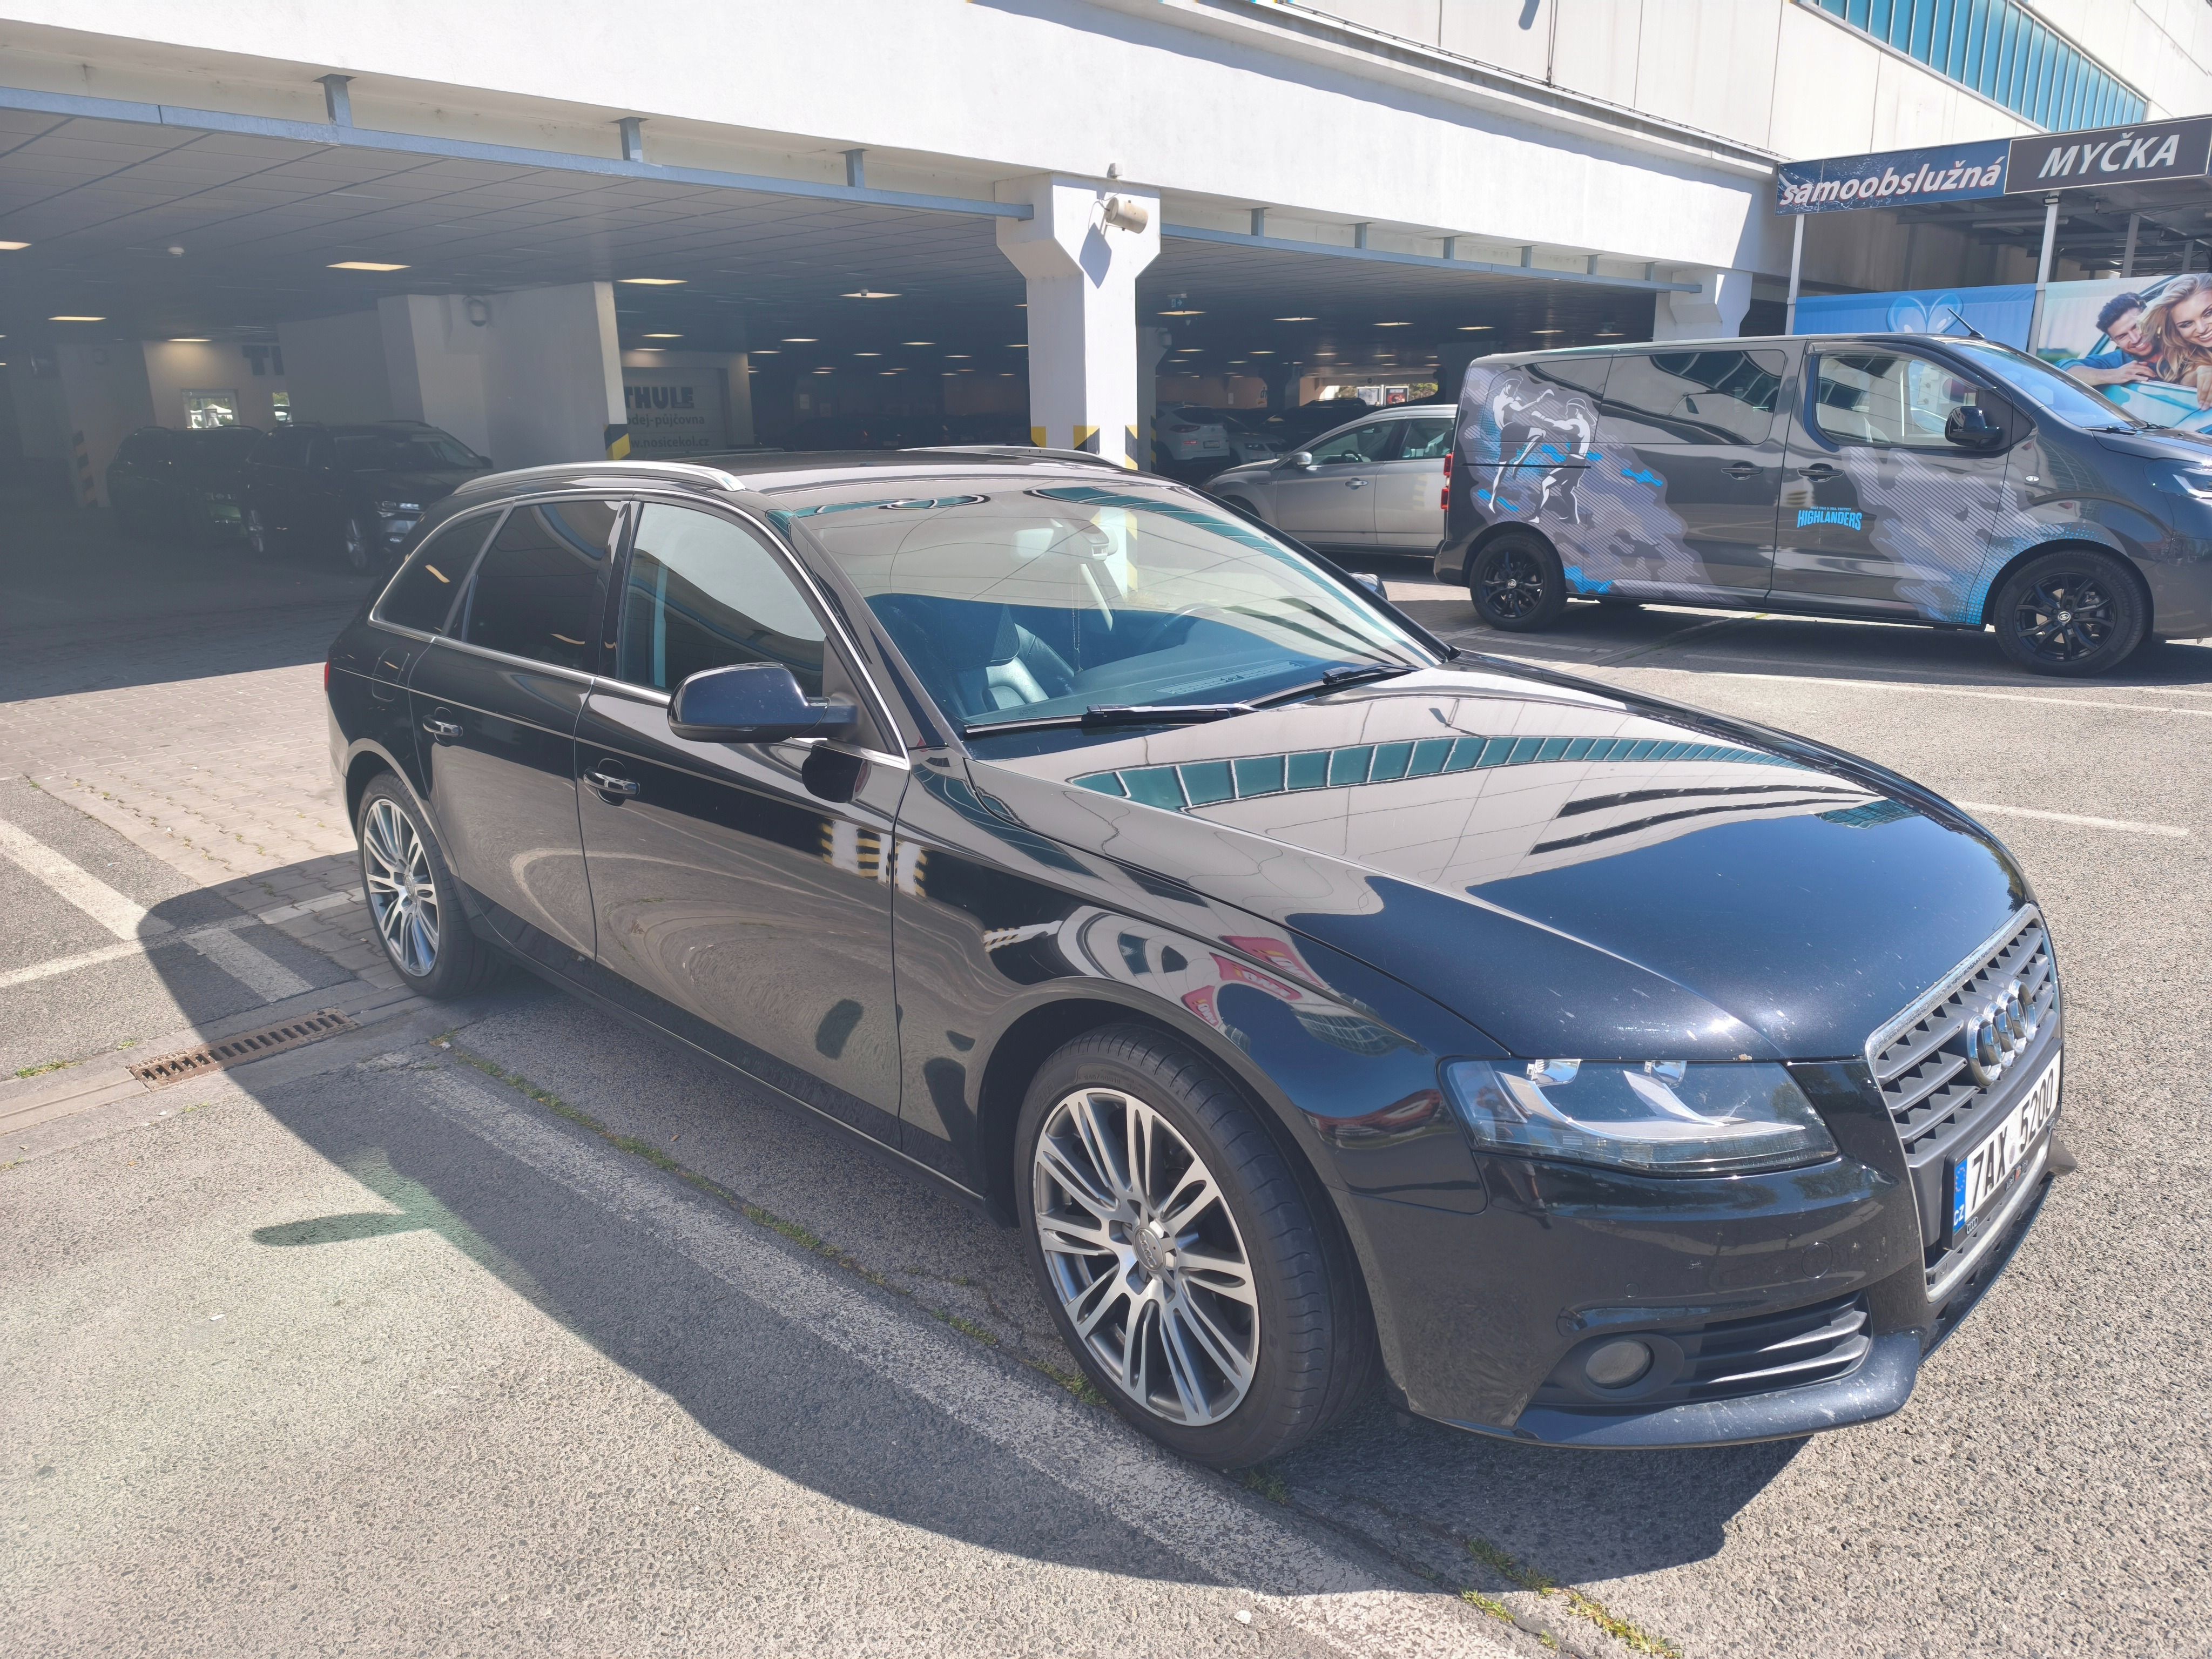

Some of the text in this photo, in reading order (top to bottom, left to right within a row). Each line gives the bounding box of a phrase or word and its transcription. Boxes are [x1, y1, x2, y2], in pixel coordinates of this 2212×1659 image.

[2037, 131, 2180, 179] MYČKA
[1779, 156, 2006, 206] samoobslužná
[624, 386, 694, 409] THULE
[1797, 510, 1863, 531] HIGHLANDERS
[1972, 1068, 2054, 1212] 7AX 5200
[1953, 1204, 1965, 1226] CZ
